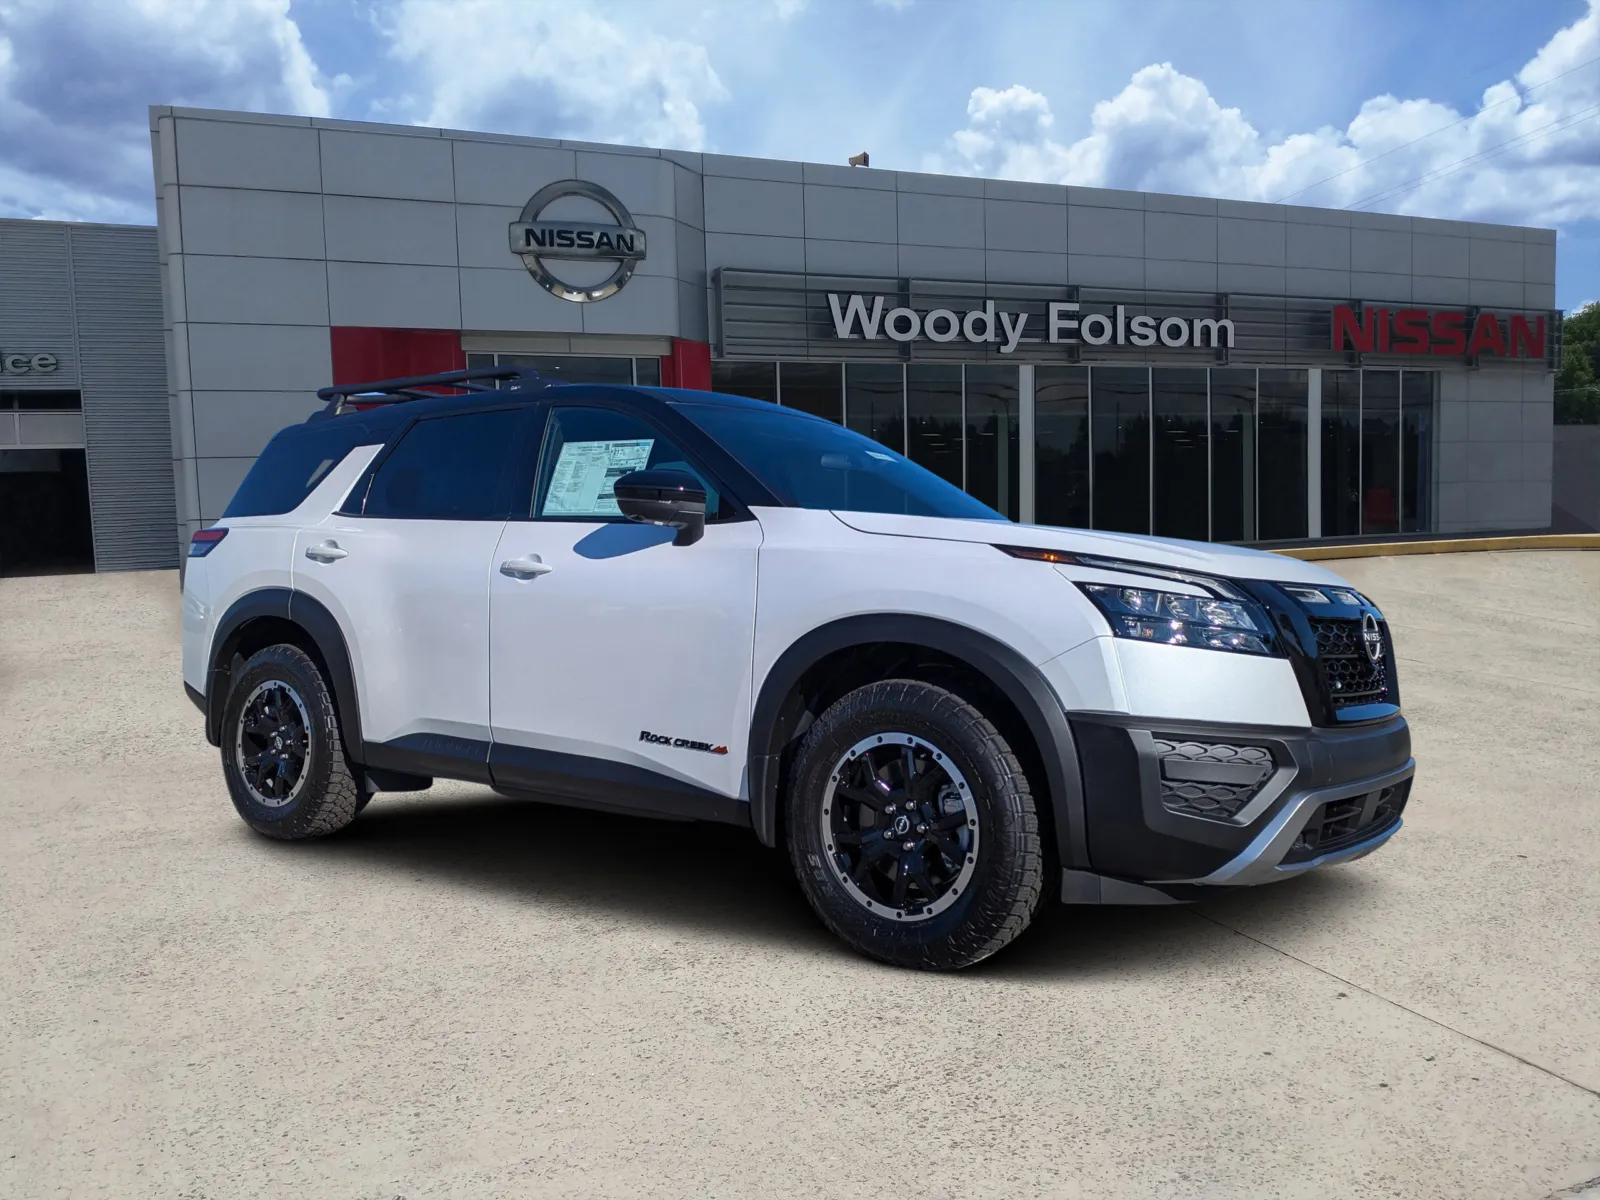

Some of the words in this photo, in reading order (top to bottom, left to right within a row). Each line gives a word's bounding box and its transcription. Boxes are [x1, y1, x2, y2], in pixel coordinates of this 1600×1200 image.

[525, 229, 634, 252] NISSAN
[827, 293, 1028, 354] Woody
[1048, 301, 1235, 348] Folsom
[1332, 305, 1546, 359] NISSAN
[0, 353, 57, 374] ce
[1363, 632, 1381, 641] NISS
[673, 738, 714, 752] CREEK
